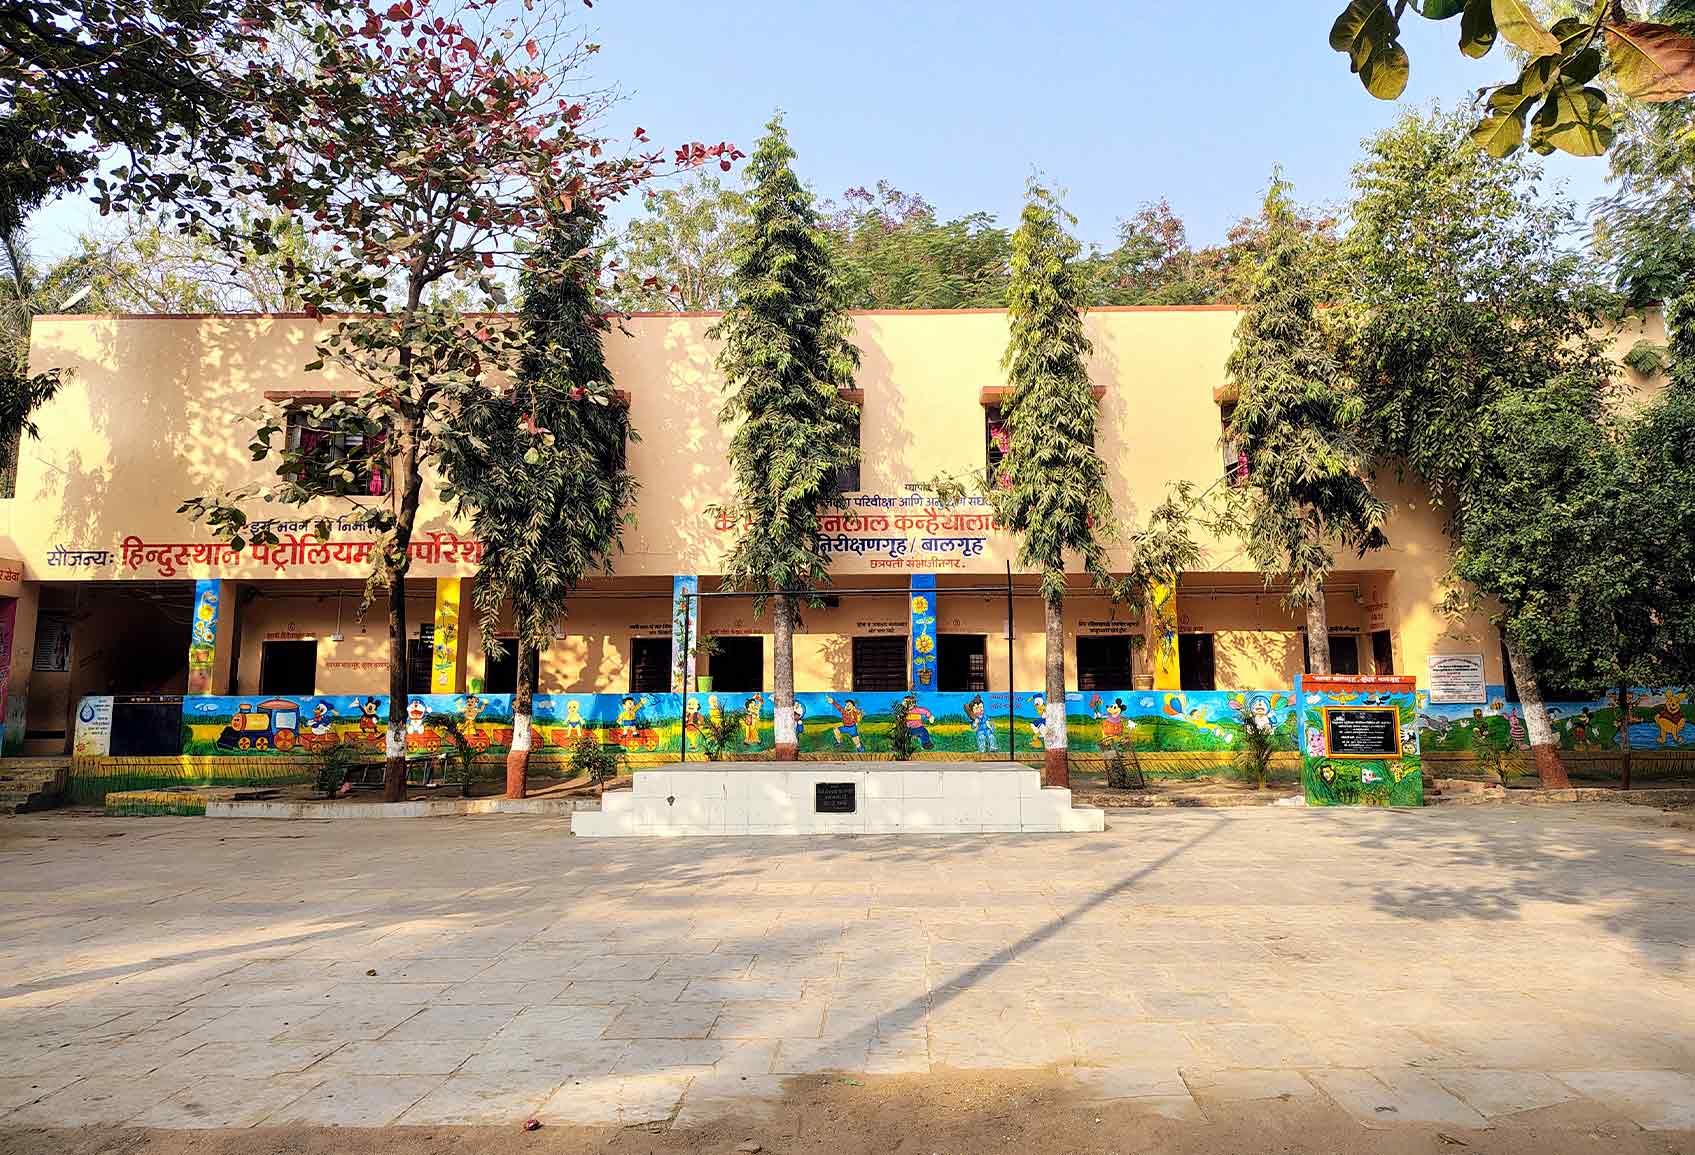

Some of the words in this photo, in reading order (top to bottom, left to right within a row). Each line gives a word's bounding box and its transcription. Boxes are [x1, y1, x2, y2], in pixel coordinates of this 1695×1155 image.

[853, 494, 897, 509] परिवीक्षा
[899, 493, 923, 508] आणि
[921, 537, 986, 557] बालगृह
[119, 536, 241, 577] हिन्दुस्थान
[869, 558, 904, 569] छत्रपती
